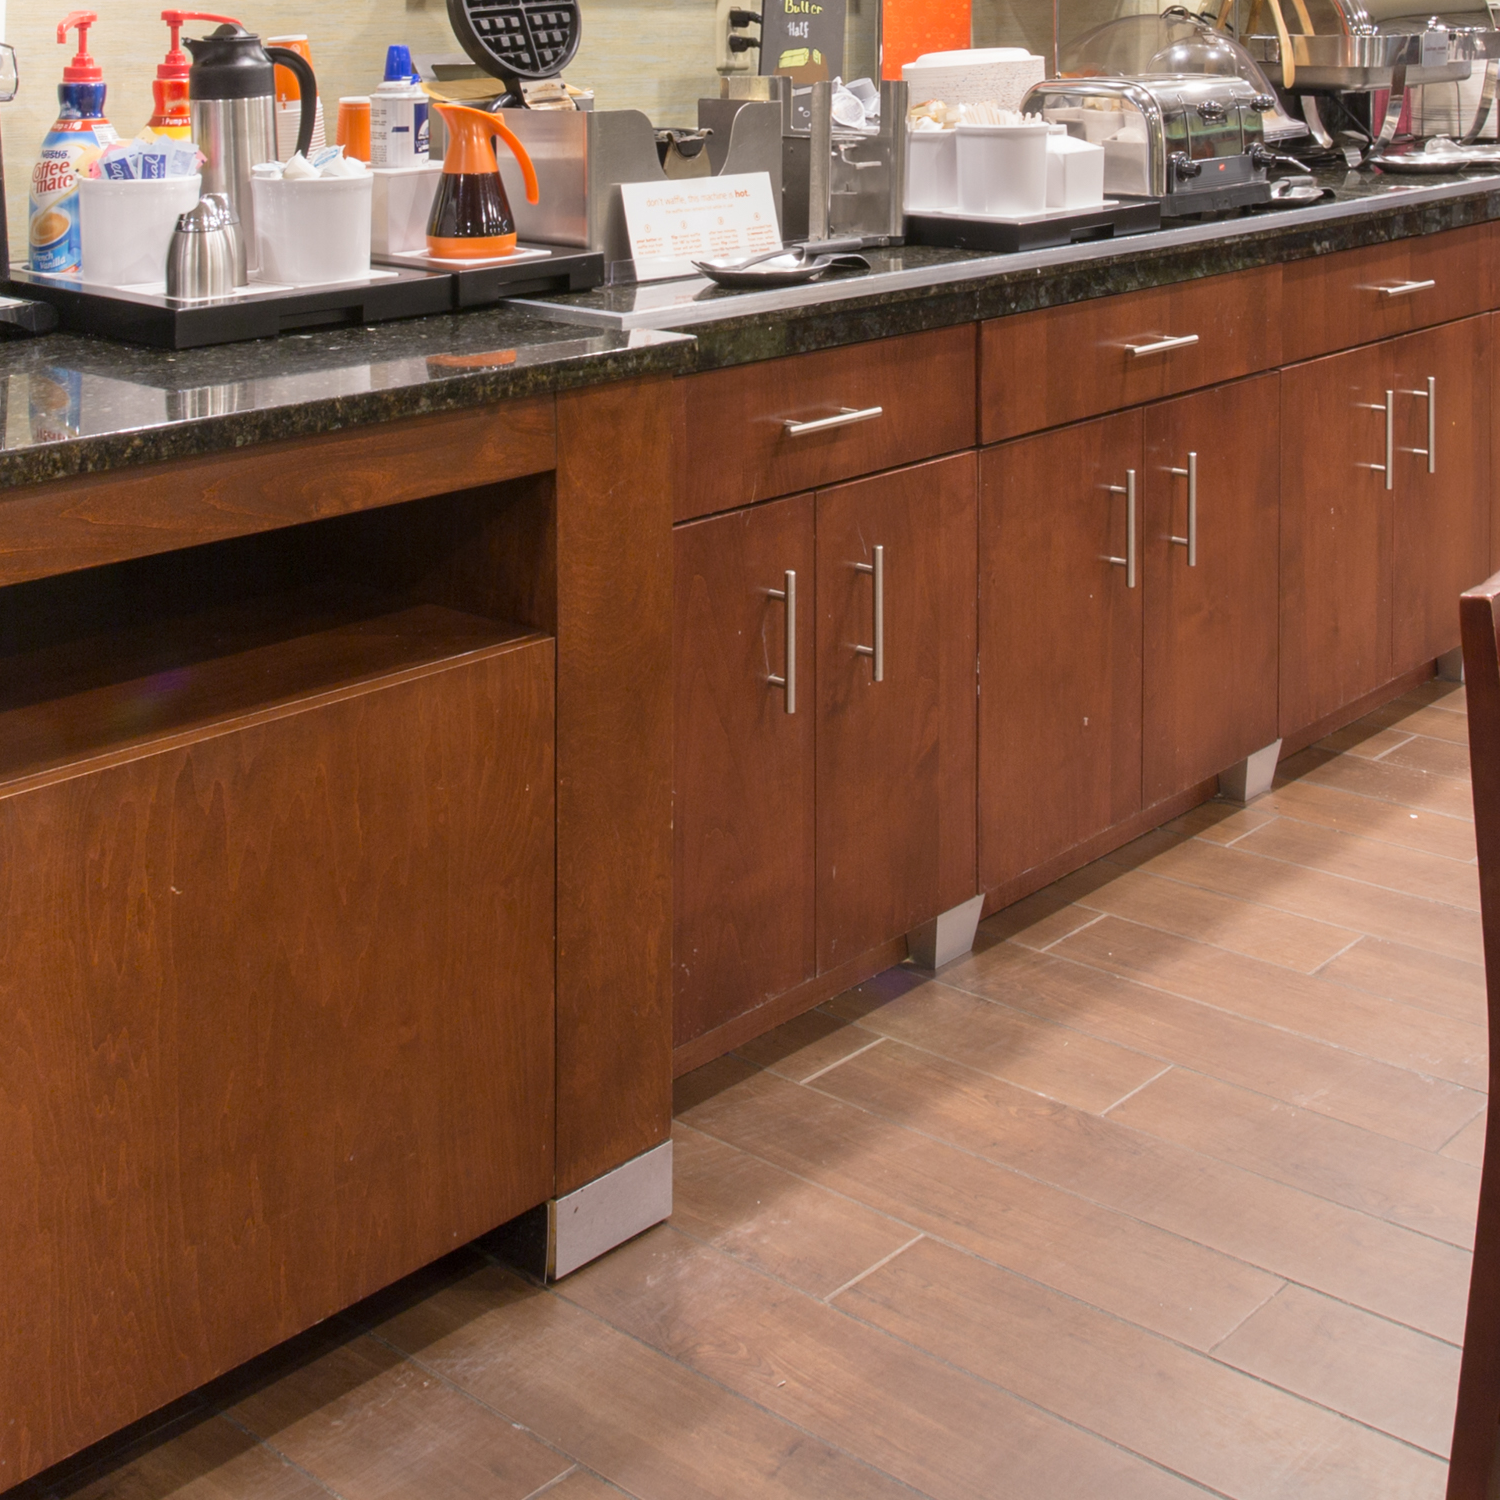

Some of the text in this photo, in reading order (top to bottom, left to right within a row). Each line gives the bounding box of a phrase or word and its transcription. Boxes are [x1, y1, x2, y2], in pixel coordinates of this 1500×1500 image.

[787, 21, 809, 39] Half
[166, 116, 183, 127] Pump
[36, 173, 74, 195] mate
[734, 189, 751, 198] hot.
